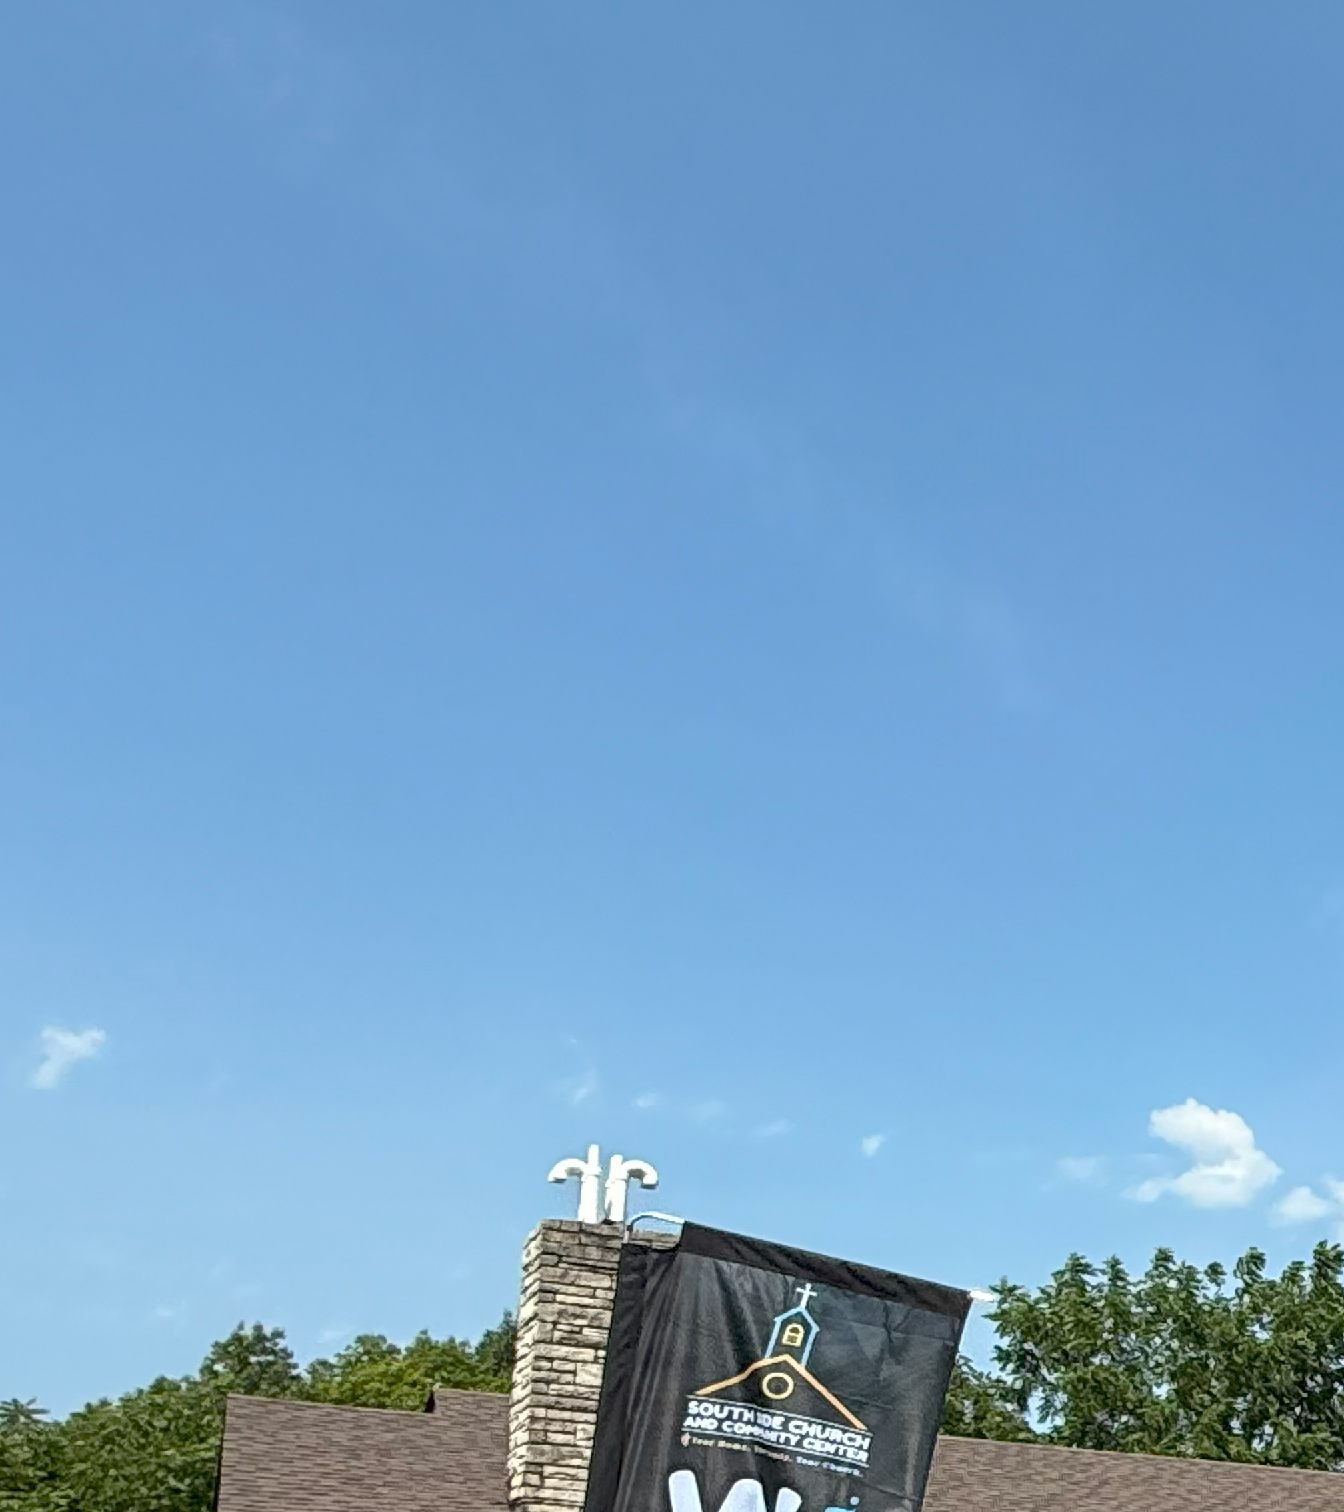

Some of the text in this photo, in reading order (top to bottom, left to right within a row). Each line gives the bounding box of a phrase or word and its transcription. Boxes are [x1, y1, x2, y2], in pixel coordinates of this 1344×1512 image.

[683, 1416, 718, 1431] AND
[802, 1437, 869, 1462] CENTER
[687, 1400, 755, 1422] SOUTH
[788, 1420, 871, 1450] CHURCH
